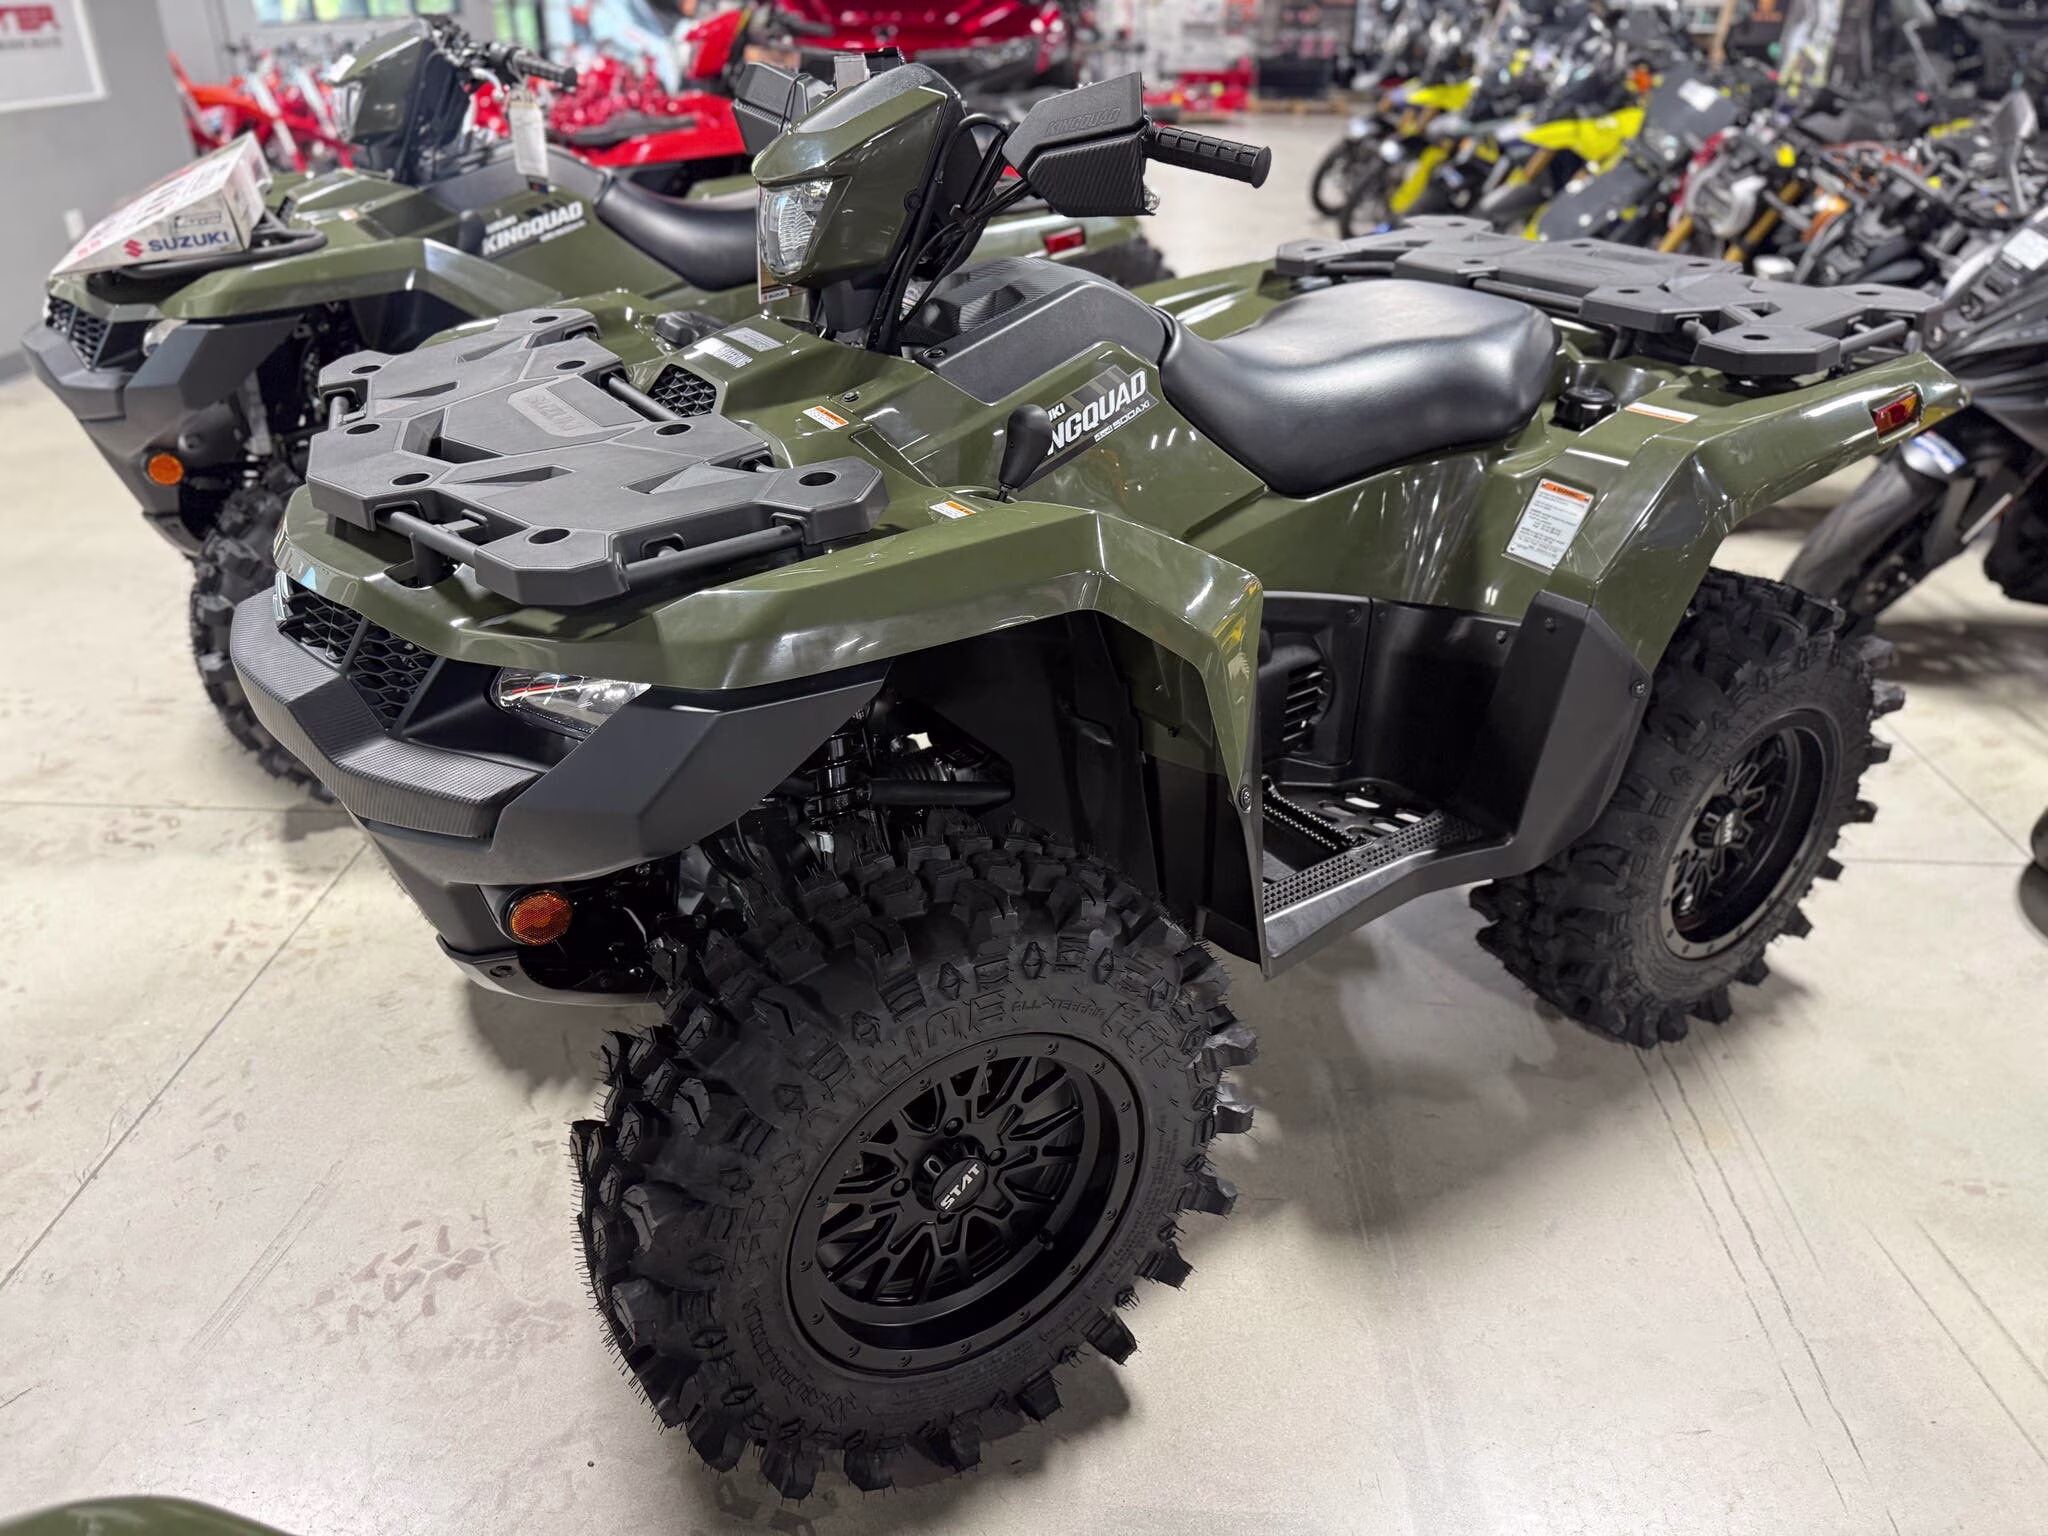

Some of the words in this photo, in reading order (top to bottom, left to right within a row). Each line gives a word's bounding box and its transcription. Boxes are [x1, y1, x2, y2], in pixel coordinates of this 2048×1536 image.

[148, 231, 230, 253] SUZUKI
[1046, 370, 1147, 457] NGQUAD
[940, 1163, 980, 1210] STAT
